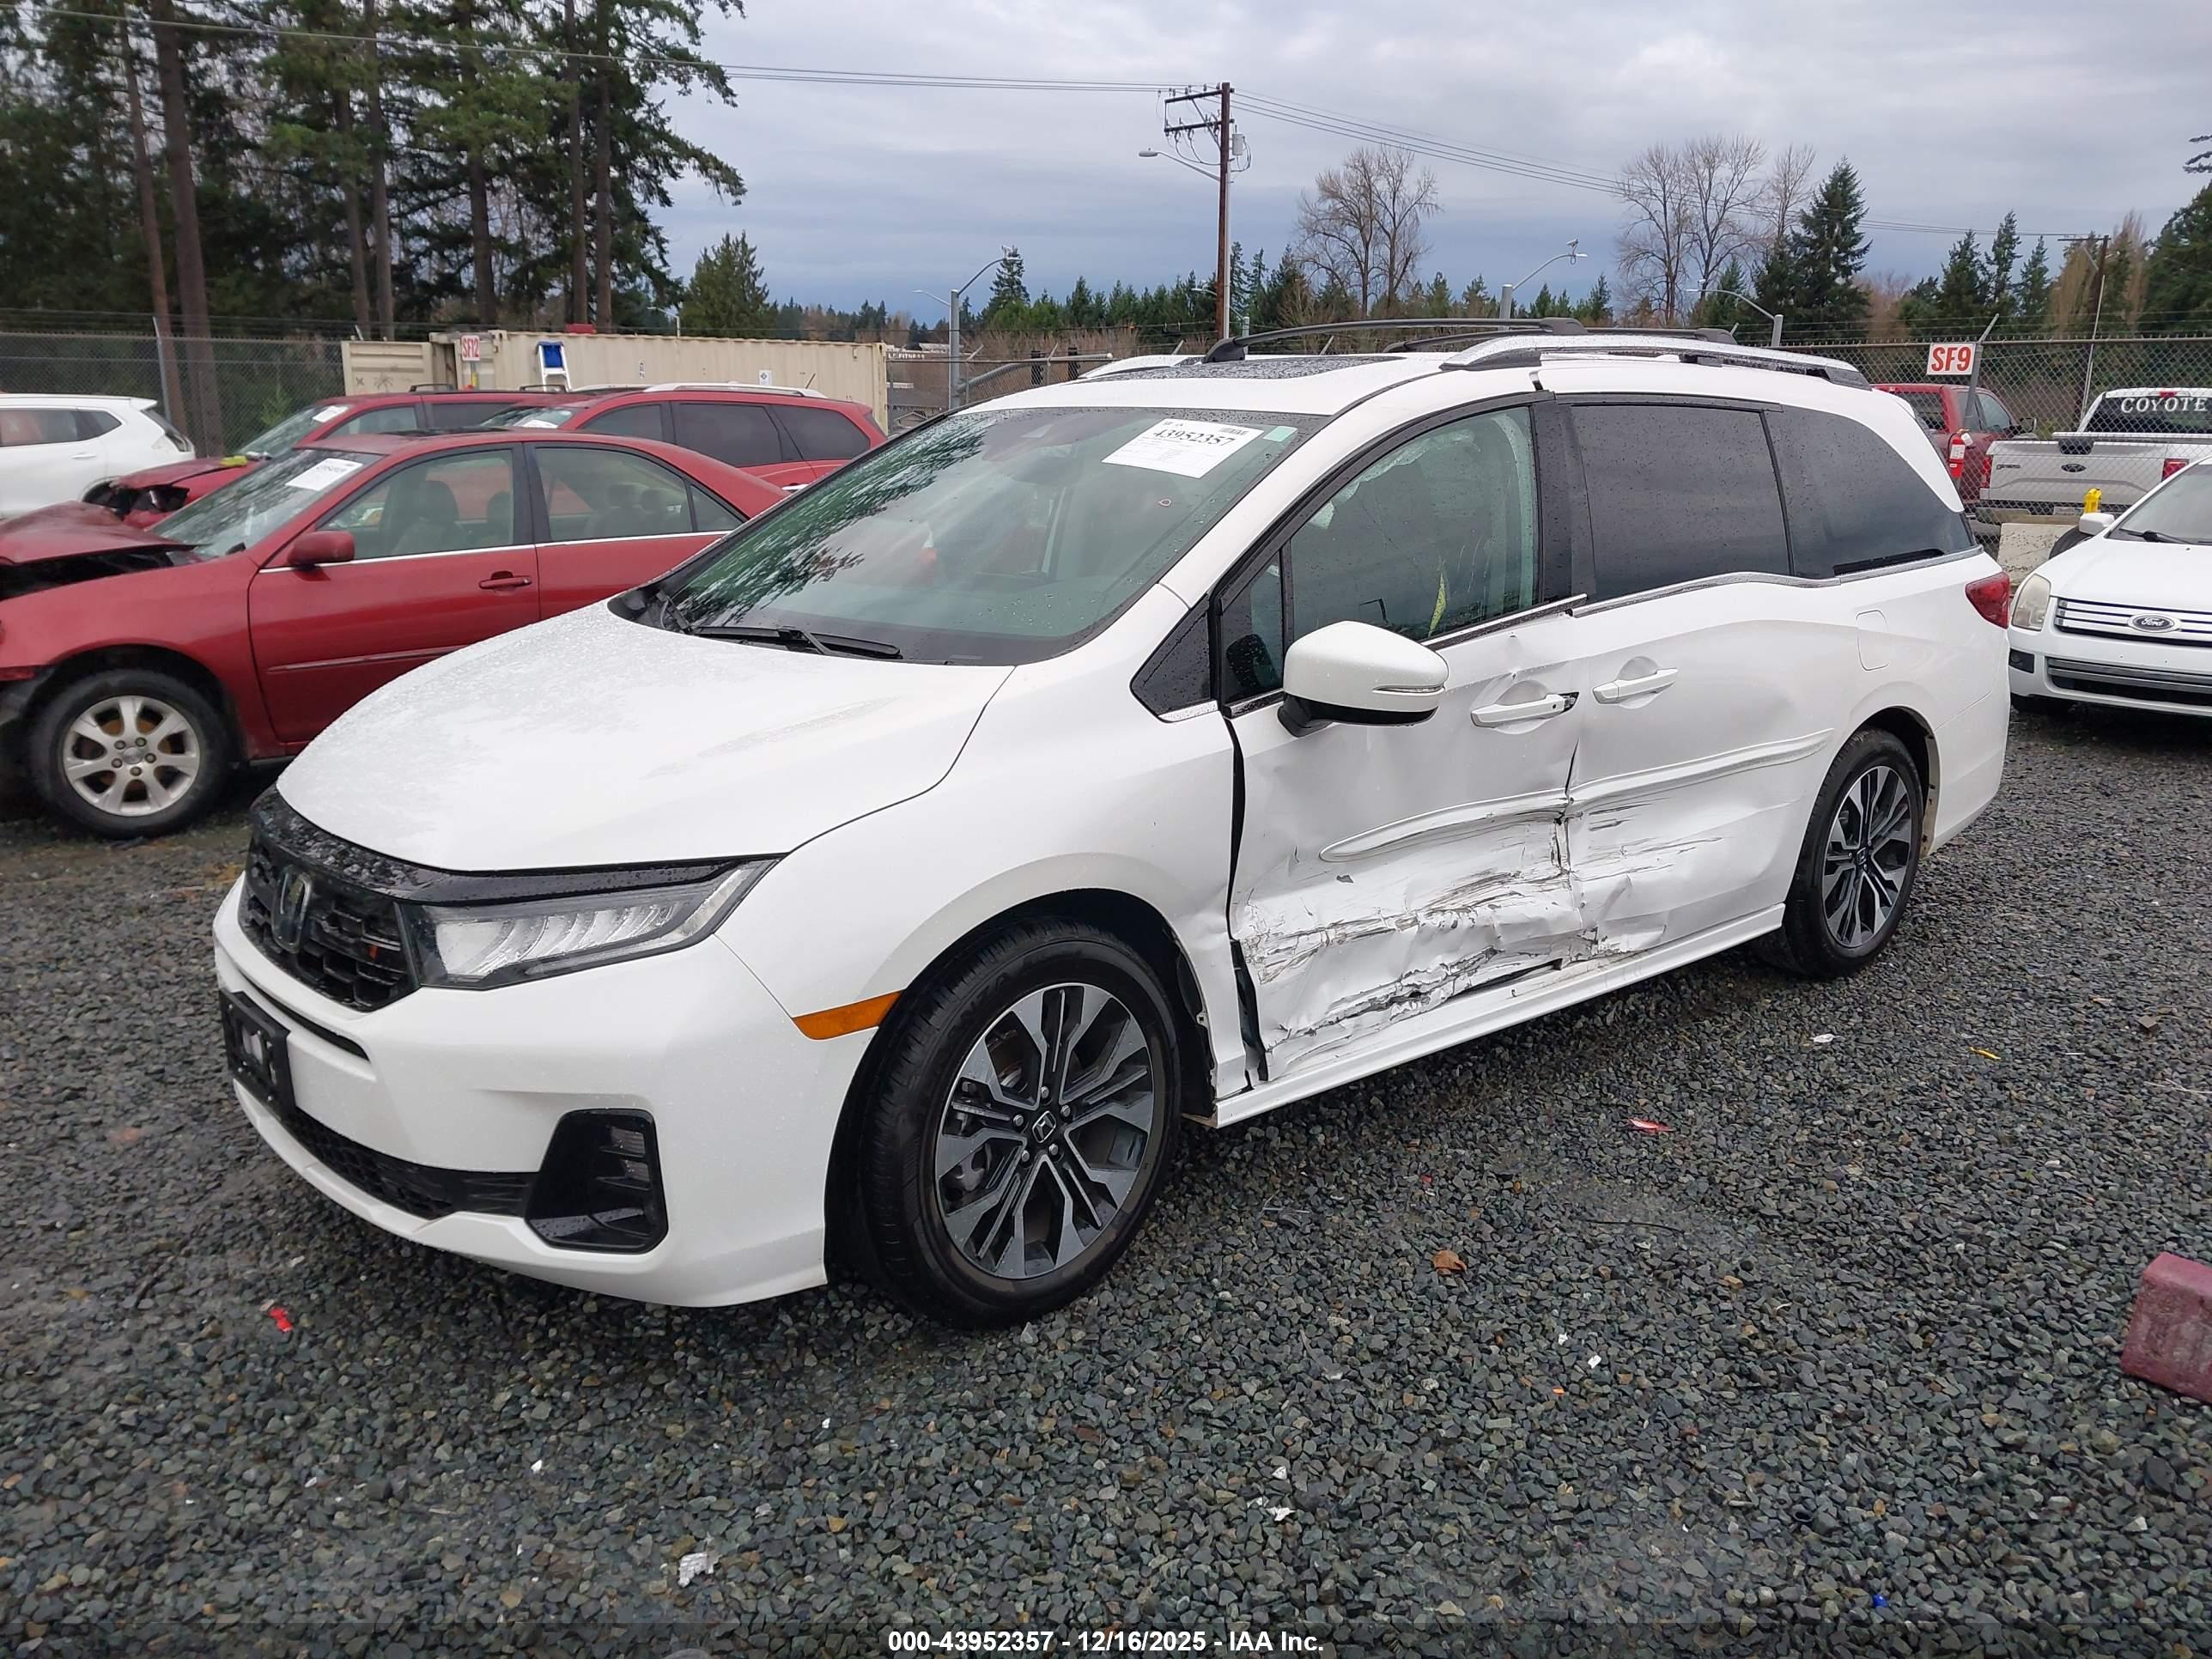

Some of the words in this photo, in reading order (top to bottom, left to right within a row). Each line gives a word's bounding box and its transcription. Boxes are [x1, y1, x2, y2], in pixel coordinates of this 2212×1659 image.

[462, 337, 479, 358] SF12
[1930, 346, 1972, 372] SF9
[2120, 397, 2209, 414] COYOTE
[1153, 428, 1236, 446] 43952357
[2141, 617, 2165, 626] Ford
